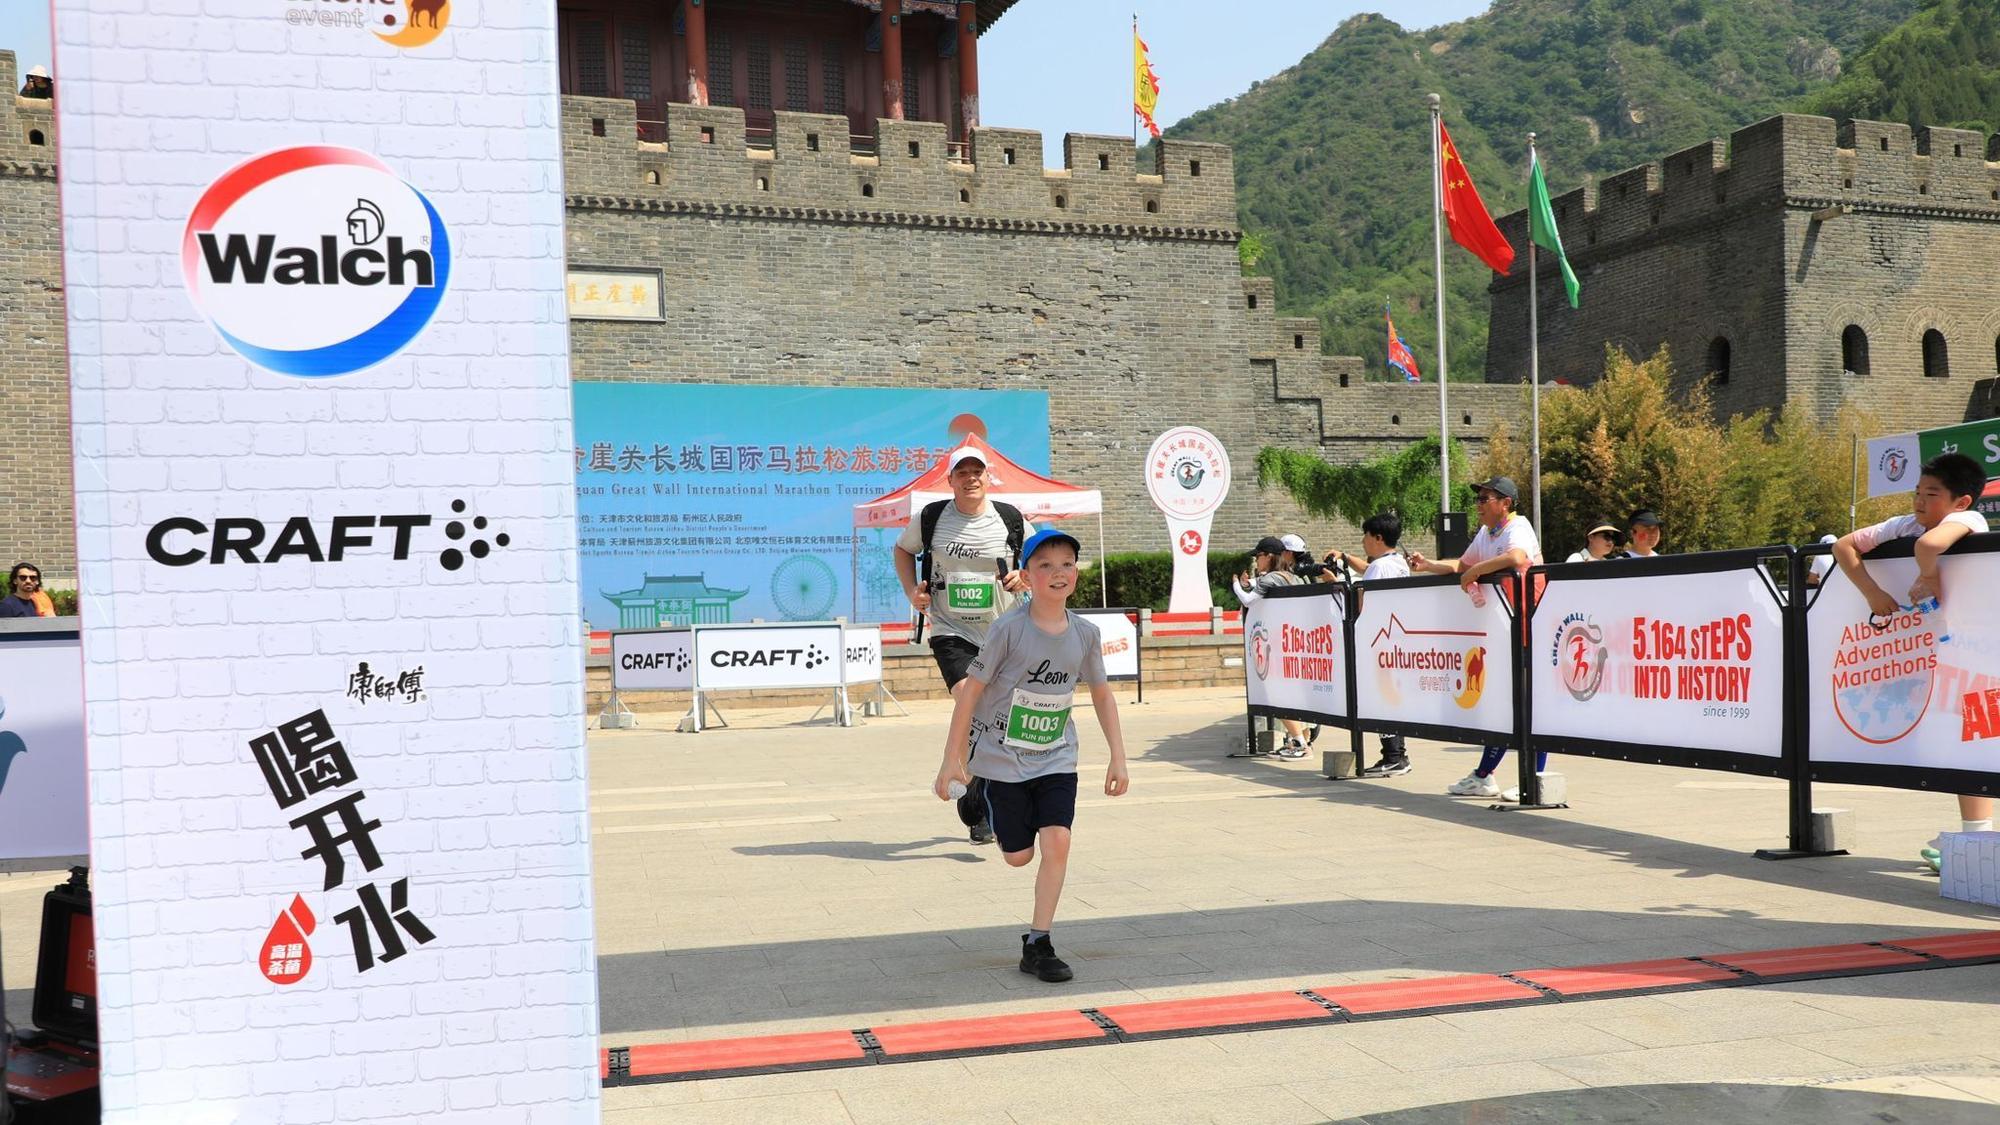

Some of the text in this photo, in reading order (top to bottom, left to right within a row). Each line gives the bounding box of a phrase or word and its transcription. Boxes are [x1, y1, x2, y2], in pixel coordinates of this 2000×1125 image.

[286, 7, 364, 28] event
[197, 233, 434, 287] Walch
[611, 483, 646, 496] Great
[653, 483, 681, 496] Wall
[687, 483, 768, 496] International
[774, 483, 830, 496] Marathon
[836, 483, 885, 496] Tourism
[146, 514, 432, 567] CRAFT
[954, 588, 983, 600] 1002
[1563, 611, 1585, 627] WALL
[1282, 623, 1305, 653] 5.164
[1306, 624, 1333, 655] STEPS
[1633, 613, 1752, 661] 5.164 STEPS
[621, 652, 675, 670] CRAFT
[710, 649, 804, 668] CRAFT
[1378, 645, 1462, 671] culturestone
[1834, 632, 1934, 669] Adventure
[1027, 659, 1070, 686] Leon
[1283, 656, 1334, 683] INTO HISTORY
[1832, 653, 1938, 690] Marathons
[1419, 673, 1451, 692] event
[1634, 665, 1672, 700] INTO
[1677, 665, 1752, 703] HISTORY
[1020, 713, 1060, 732] 1003
[1703, 705, 1751, 720] since 1999
[1020, 732, 1037, 742] FUN
[248, 707, 437, 974] 喝开水
[270, 942, 303, 960] 高温
